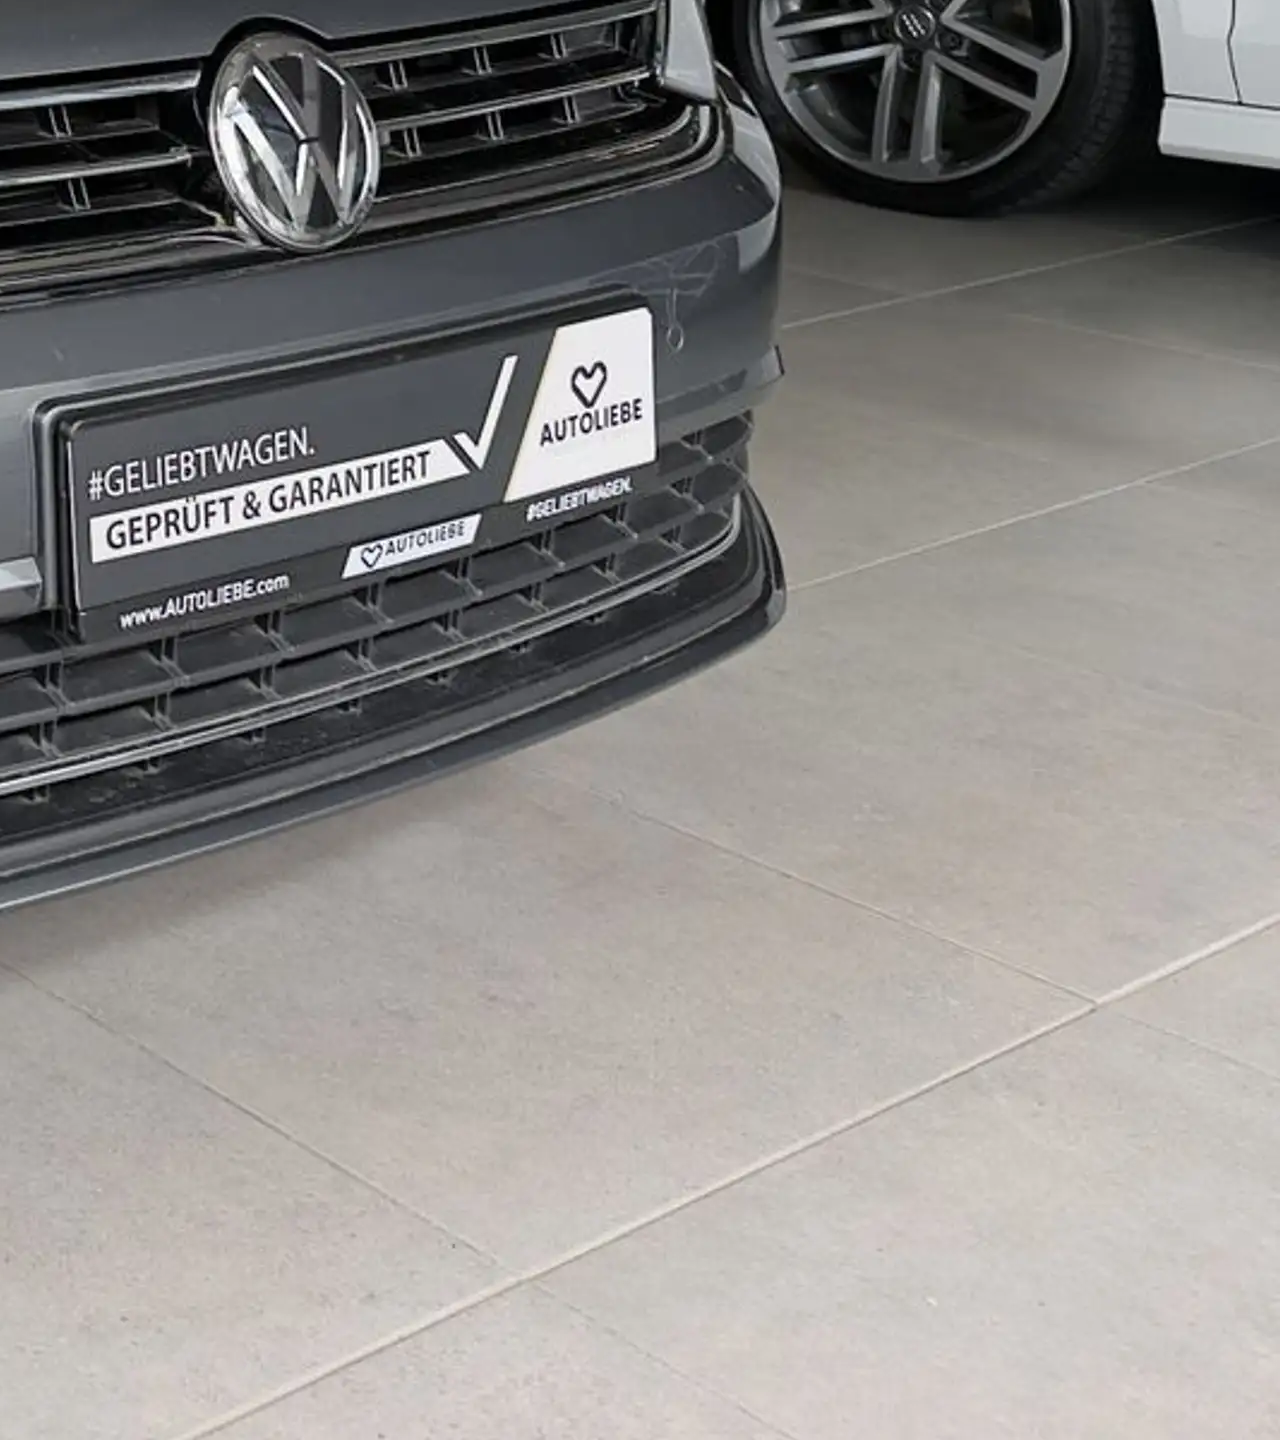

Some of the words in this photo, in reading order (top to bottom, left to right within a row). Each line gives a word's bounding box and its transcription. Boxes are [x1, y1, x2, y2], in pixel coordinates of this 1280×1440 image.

[213, 37, 376, 248] VW
[540, 398, 643, 447] AUTOLIEBE
[89, 426, 316, 501] #GELIEBTWAGEN.
[106, 496, 235, 550] GEPRÜFT
[242, 491, 262, 520] &
[269, 451, 431, 513] GARANTIERT
[385, 521, 466, 557] AUTOLIEBE
[120, 574, 290, 629] www.AUTOLIEBE.com
